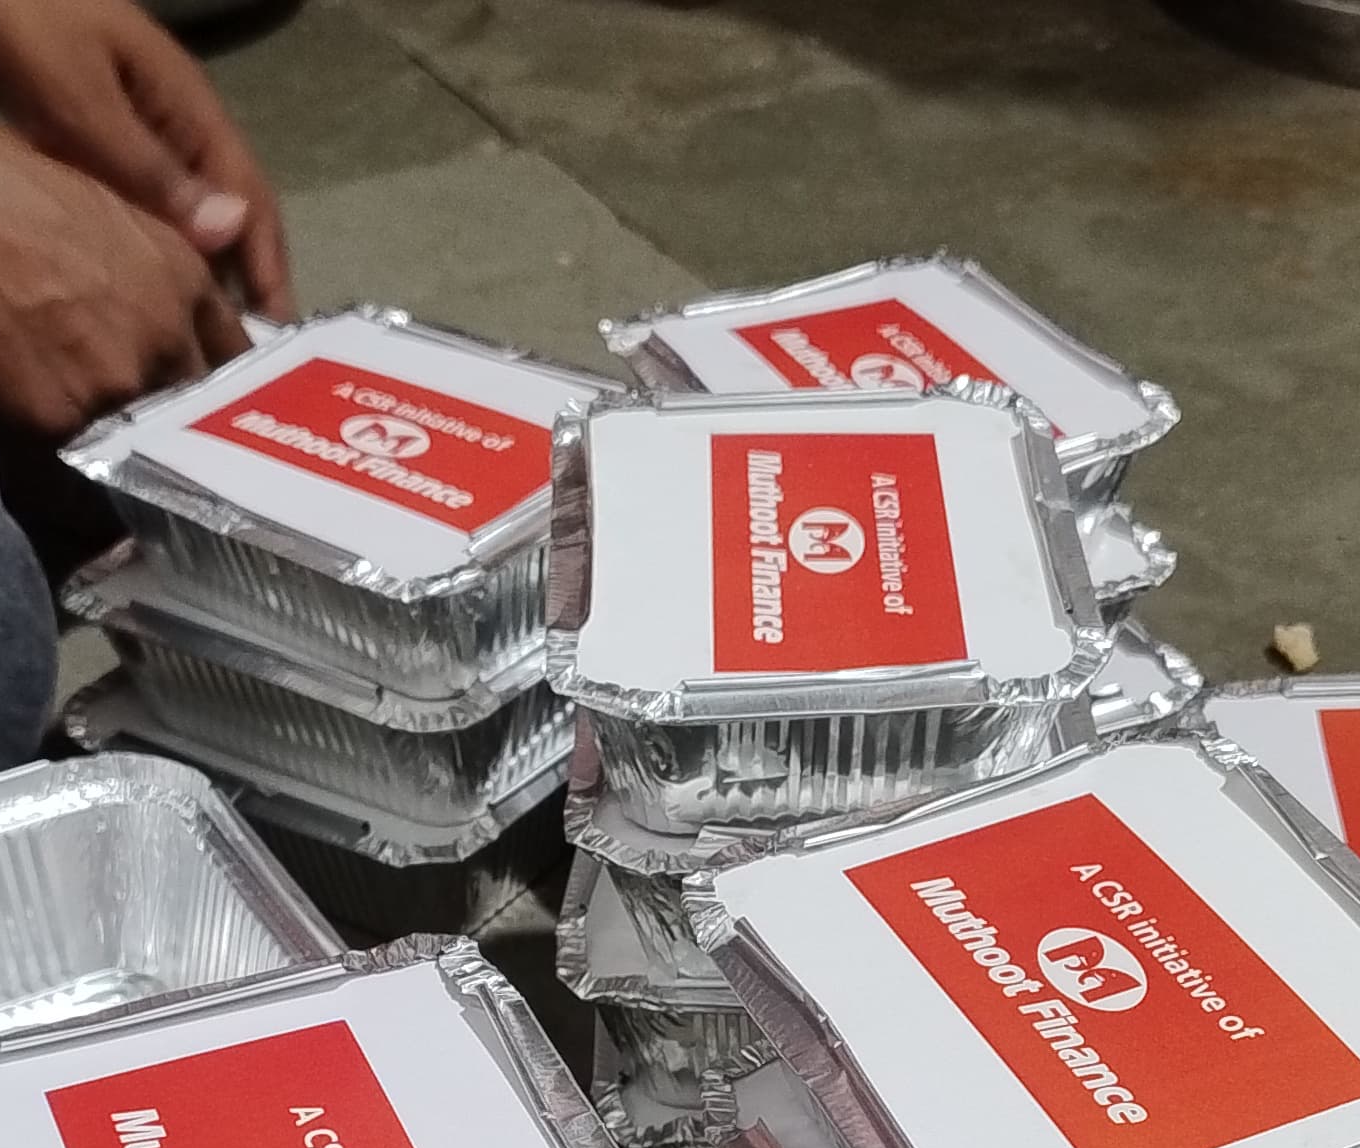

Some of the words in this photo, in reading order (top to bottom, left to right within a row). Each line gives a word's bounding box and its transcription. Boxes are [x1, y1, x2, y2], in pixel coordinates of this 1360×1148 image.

[354, 455, 475, 509] Finance
[748, 450, 784, 545] Muthoot
[870, 472, 896, 488] A
[872, 489, 901, 519] CSR
[876, 519, 908, 592] initiative
[752, 547, 788, 643] Finance
[884, 593, 913, 614] of
[1069, 863, 1104, 882] A
[1092, 879, 1143, 921] CSR
[1127, 917, 1226, 1013] initiative
[1218, 1014, 1265, 1042] of
[910, 877, 1045, 998] Muthoot
[1018, 998, 1149, 1126] Finance
[288, 1106, 325, 1127] A
